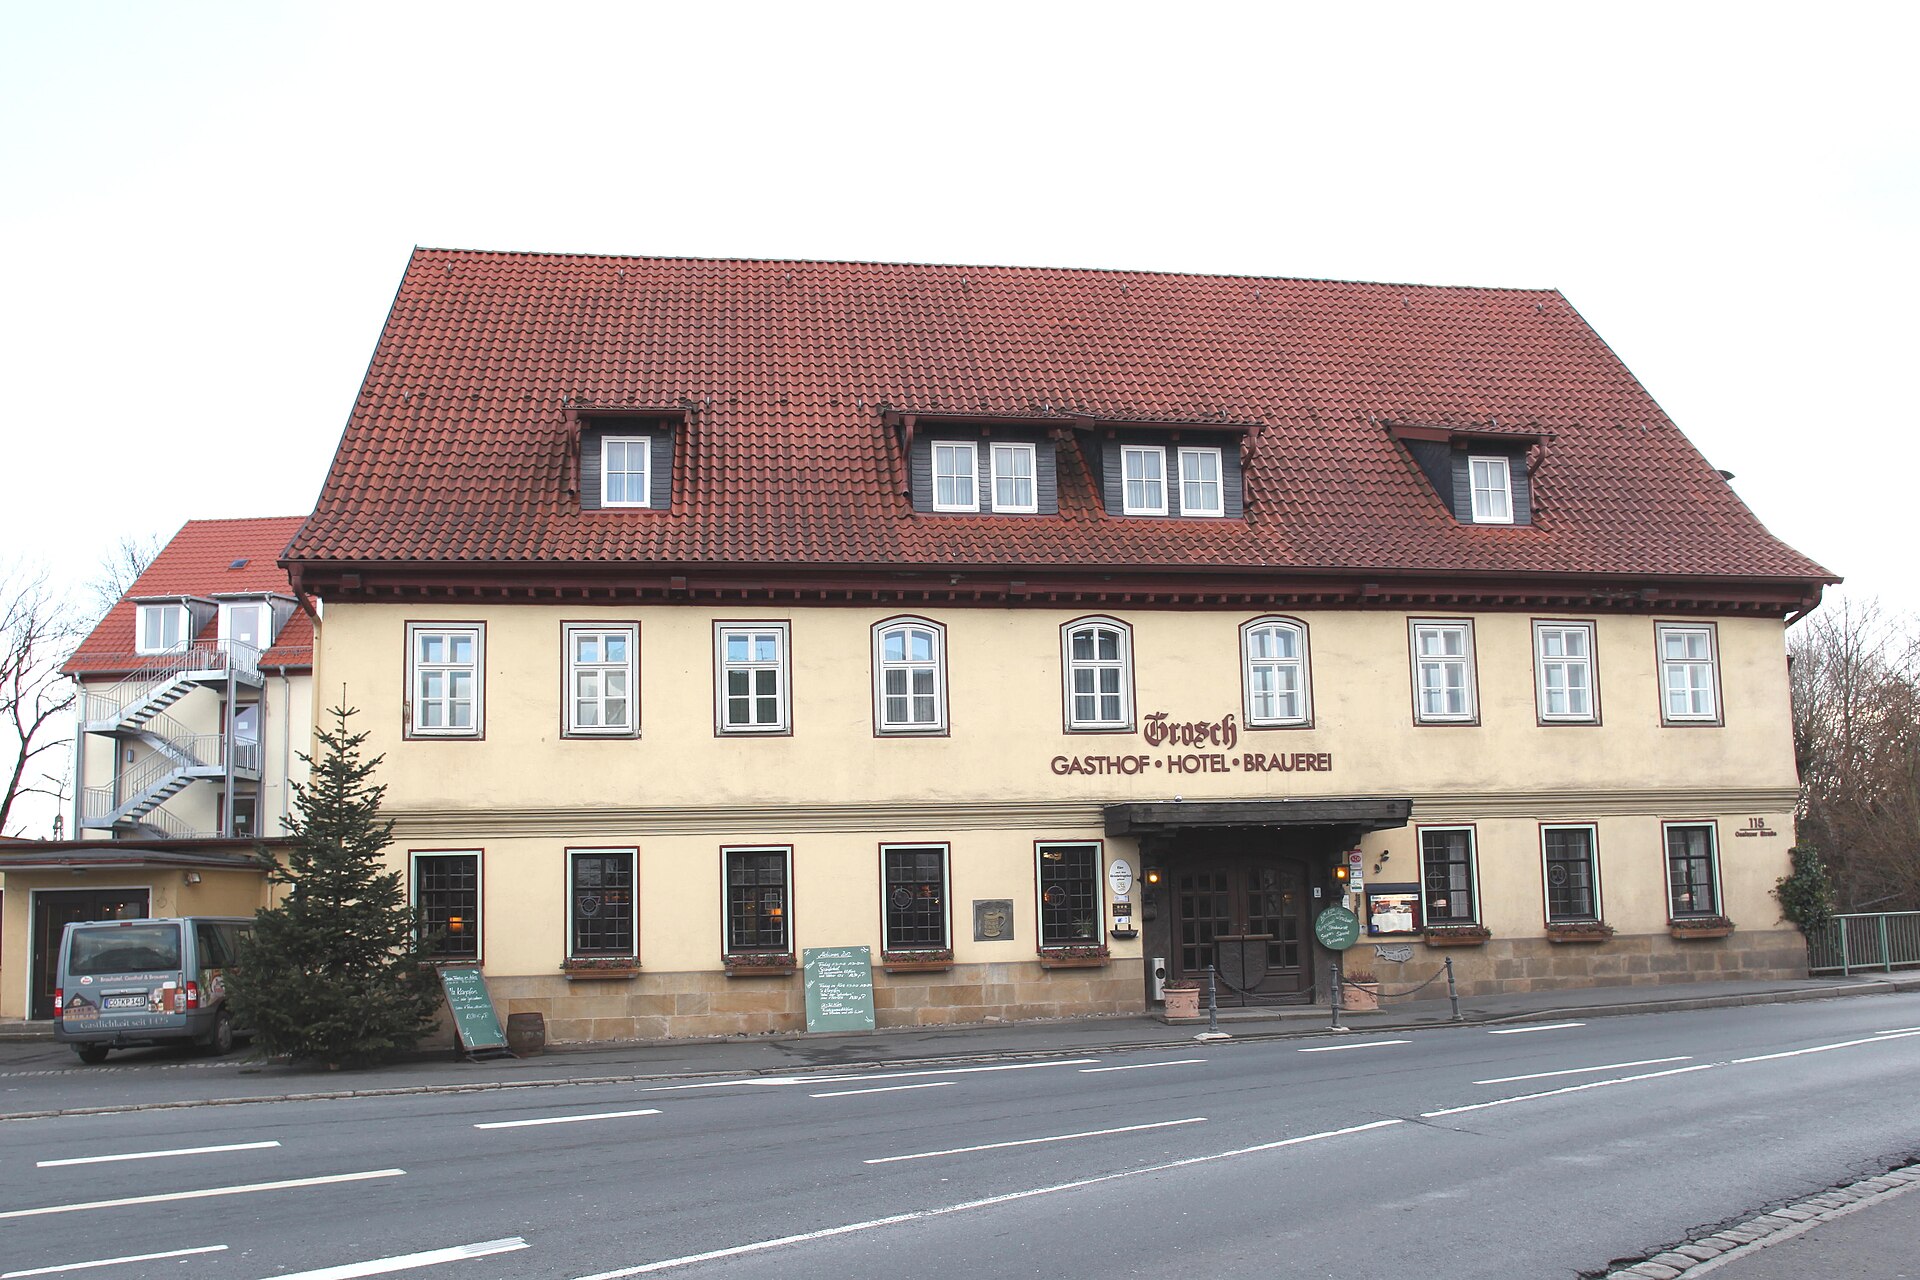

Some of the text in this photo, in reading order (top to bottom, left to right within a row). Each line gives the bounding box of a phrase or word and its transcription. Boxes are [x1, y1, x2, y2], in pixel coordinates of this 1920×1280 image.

[1143, 711, 1238, 750] Grosch
[1050, 753, 1332, 775] GASTHOF HOTEL BRAUEREI
[1748, 817, 1765, 828] 115
[80, 1019, 130, 1029] Gastlichkeit
[131, 1018, 146, 1026] seit
